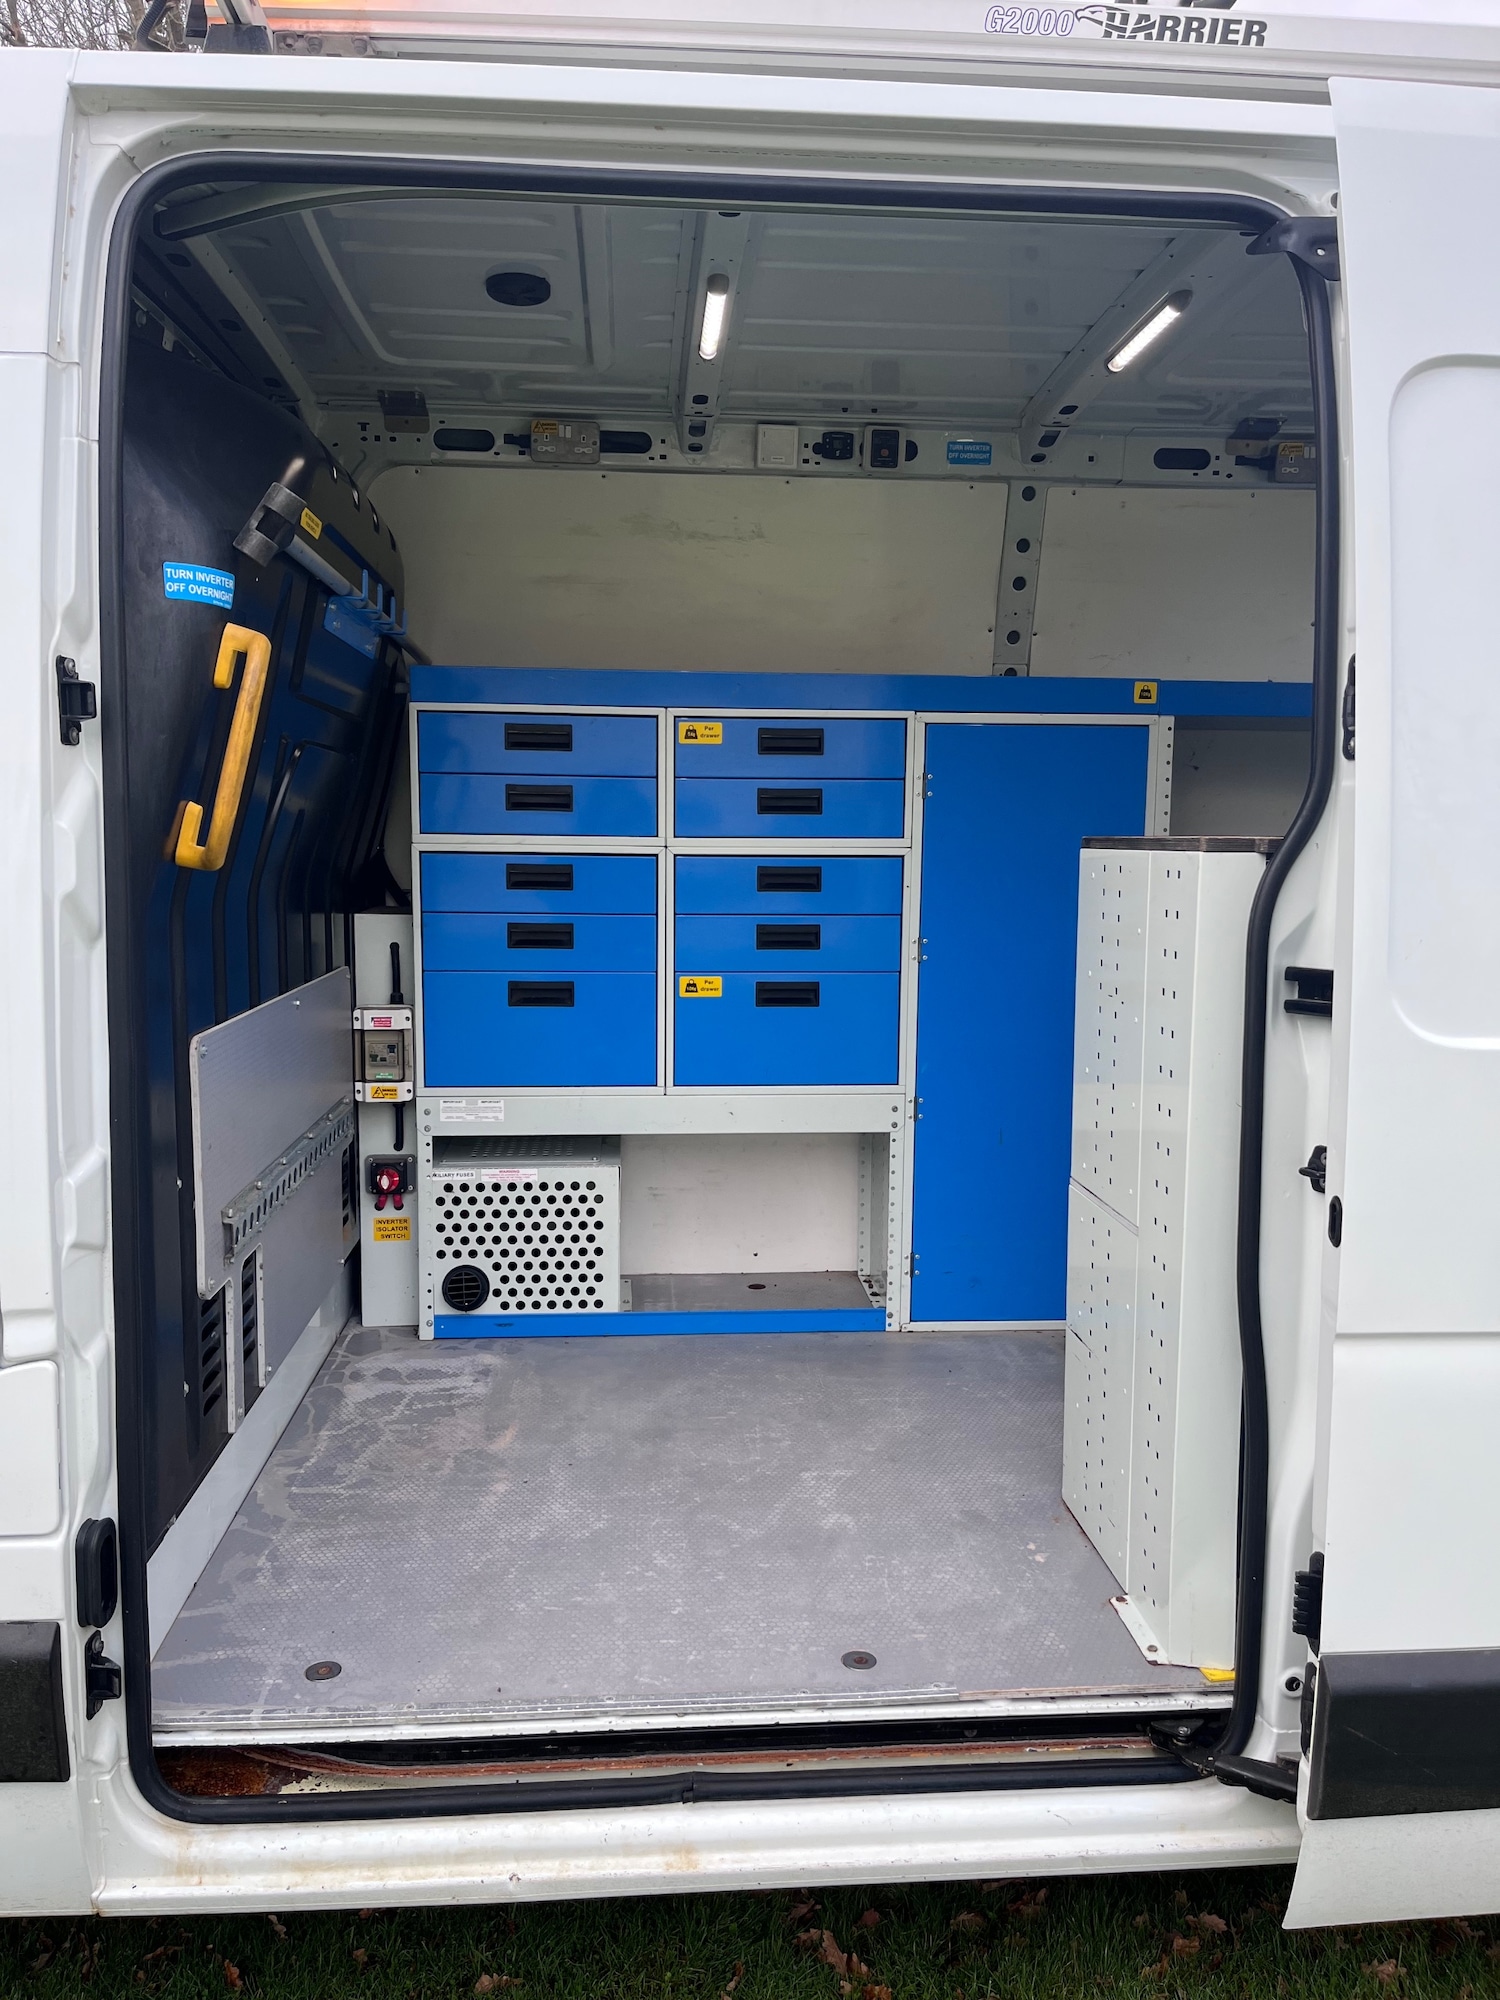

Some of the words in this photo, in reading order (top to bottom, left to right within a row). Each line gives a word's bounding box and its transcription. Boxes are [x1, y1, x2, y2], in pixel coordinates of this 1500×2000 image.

[984, 5, 1075, 37] G2000
[1101, 12, 1268, 47] HARRIER
[165, 568, 194, 580] TURN
[195, 571, 234, 589] INVERTER
[166, 581, 186, 592] OFF
[188, 584, 233, 602] OVERNIGHT
